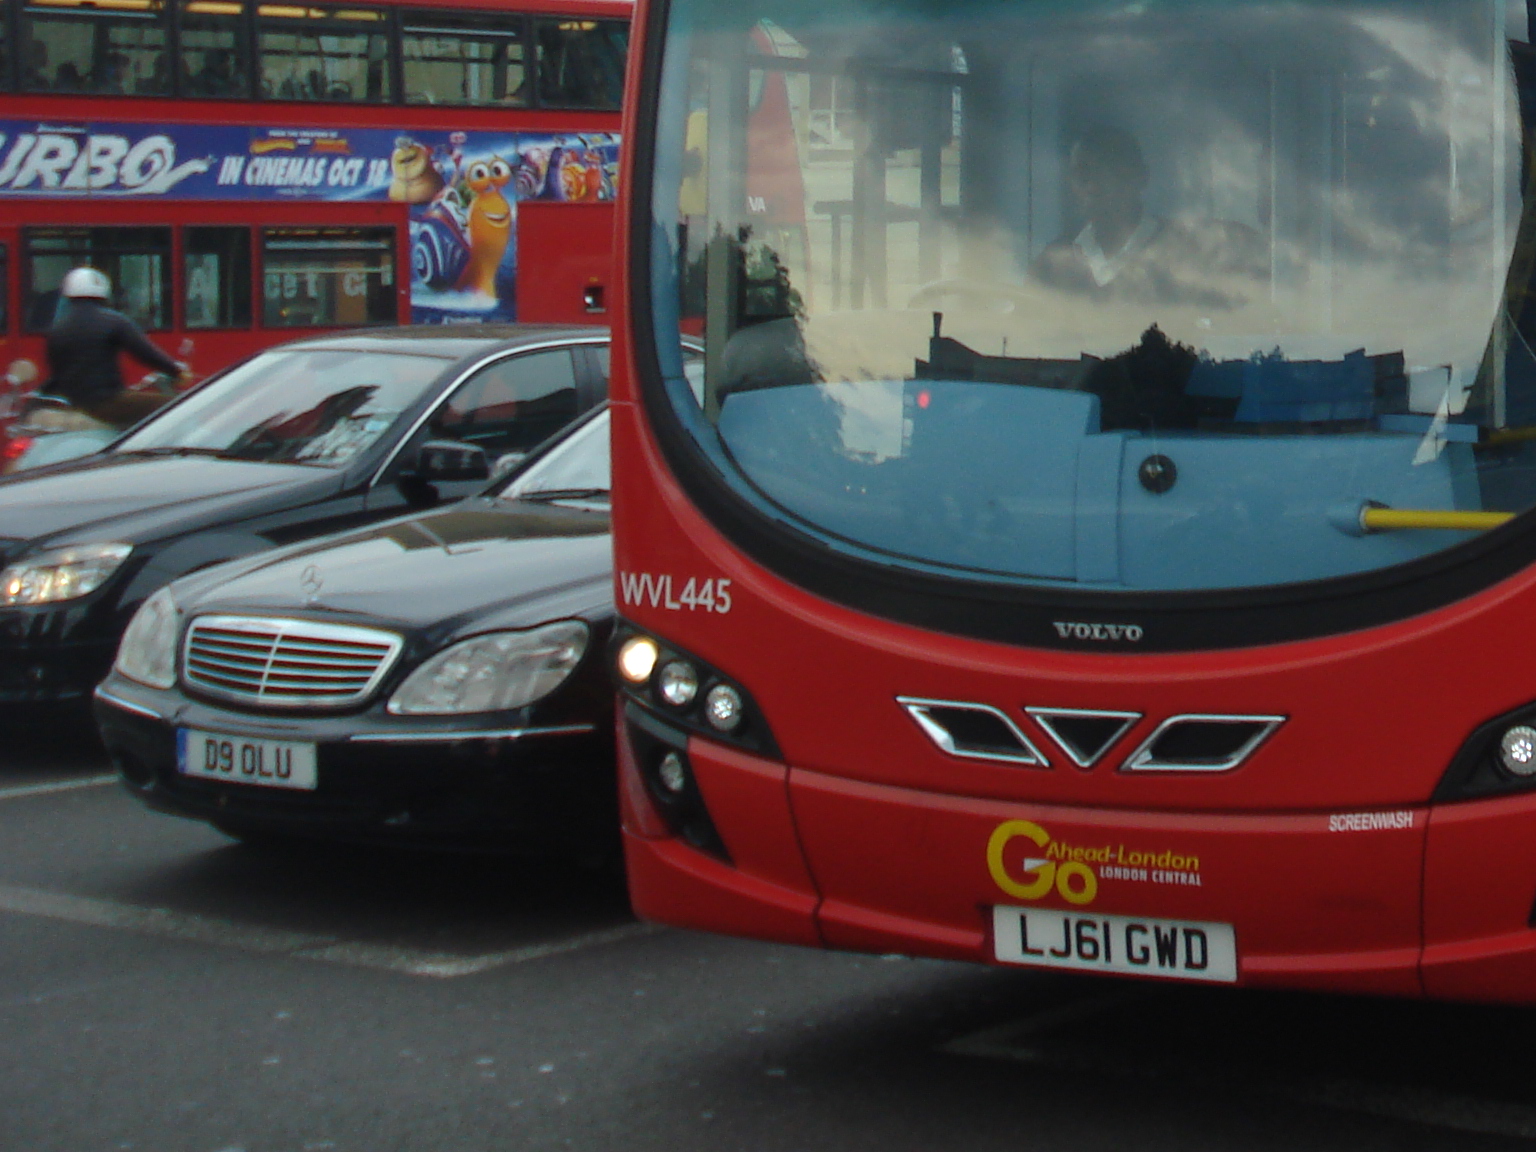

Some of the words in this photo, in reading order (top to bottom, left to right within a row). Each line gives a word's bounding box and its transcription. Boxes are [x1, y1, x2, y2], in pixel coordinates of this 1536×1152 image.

[217, 155, 246, 186] IN
[244, 156, 329, 187] CINEMAS
[327, 158, 366, 187] OCT
[366, 158, 390, 187] 18
[620, 570, 732, 615] WVL445
[1052, 621, 1144, 642] VOLVO
[205, 738, 234, 773] D9
[241, 742, 292, 779] OLU
[1328, 810, 1414, 833] SCREENWASH
[986, 819, 1098, 905] Go
[1100, 864, 1148, 882] LONDON
[1152, 870, 1202, 886] CENTRAL
[1020, 914, 1112, 963] LJ61
[1125, 923, 1209, 971] GWD
